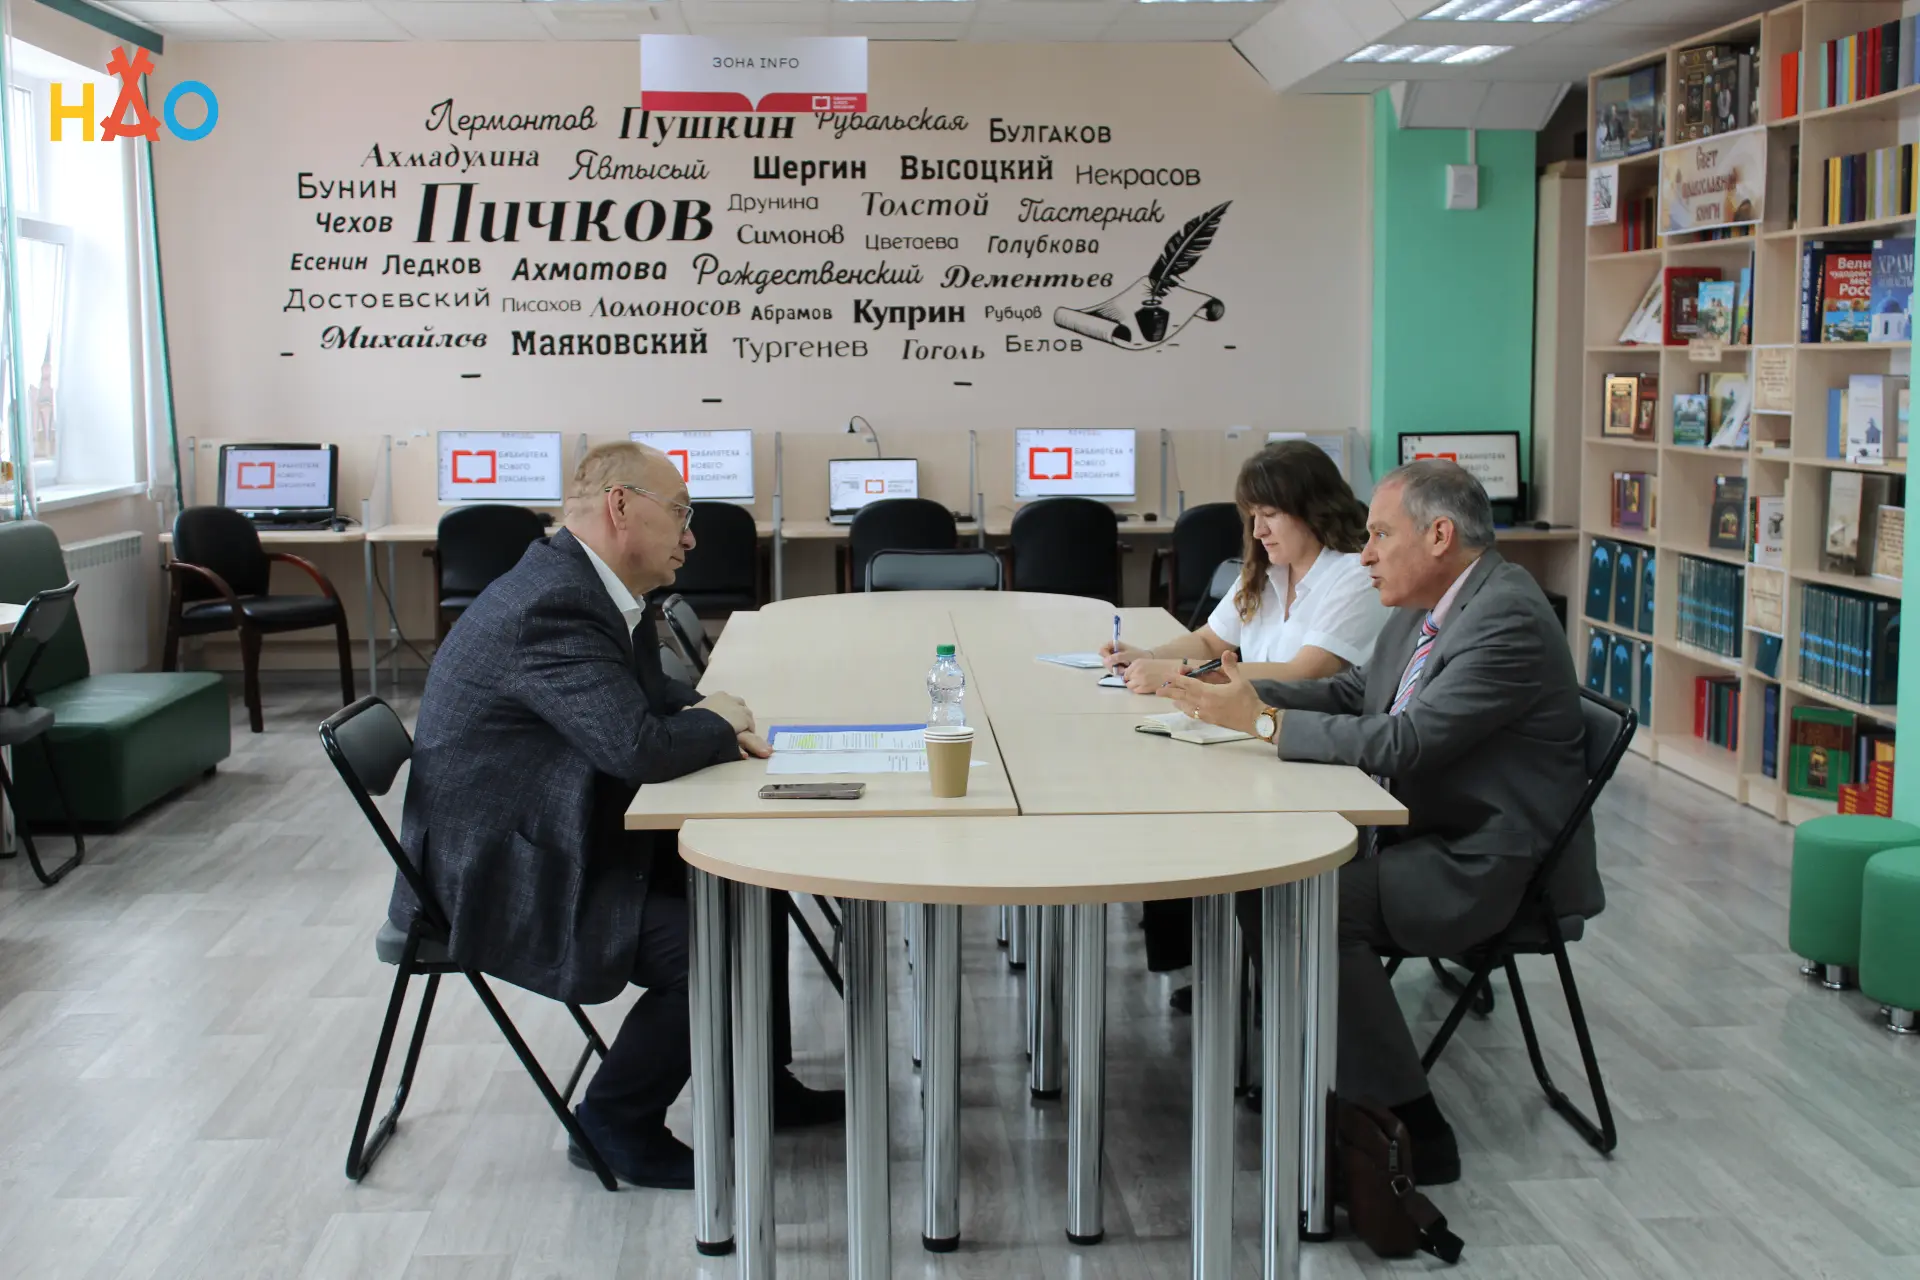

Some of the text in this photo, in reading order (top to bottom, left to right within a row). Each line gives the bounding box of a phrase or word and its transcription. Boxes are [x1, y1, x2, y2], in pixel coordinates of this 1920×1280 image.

[713, 57, 799, 69] ЗОНА INFO
[426, 98, 597, 140] Лермонтов
[619, 106, 795, 147] Пушкин
[815, 108, 968, 139] Рубальская
[361, 144, 538, 173] Ахмадулина
[569, 146, 709, 180] Явтысый
[754, 156, 865, 186] Шергин
[1077, 165, 1201, 189] Некрасов
[412, 182, 713, 243] Пичков
[728, 194, 818, 213] Друнина
[862, 192, 988, 216] Толстой
[1018, 198, 1164, 230] Пастернак
[317, 213, 392, 233] Чехов
[737, 224, 844, 244] Симонов
[866, 235, 958, 251] Цветаева
[988, 235, 1099, 258] Голубкова
[291, 253, 367, 270] Есенин
[382, 255, 481, 277] Ледков
[512, 258, 666, 280] Ахматова
[693, 249, 923, 294] Рождественский
[940, 265, 1113, 288] Дементьев
[503, 298, 581, 312] Писахов
[590, 298, 740, 317] Ломоносов
[751, 305, 832, 324] Абрамов
[854, 299, 964, 328] Куприн
[985, 305, 1042, 322] Рубцов
[321, 326, 487, 348] Михайлов
[512, 328, 707, 355] Маяковский
[733, 337, 868, 363] Тургенев
[903, 340, 984, 360] Гоголь
